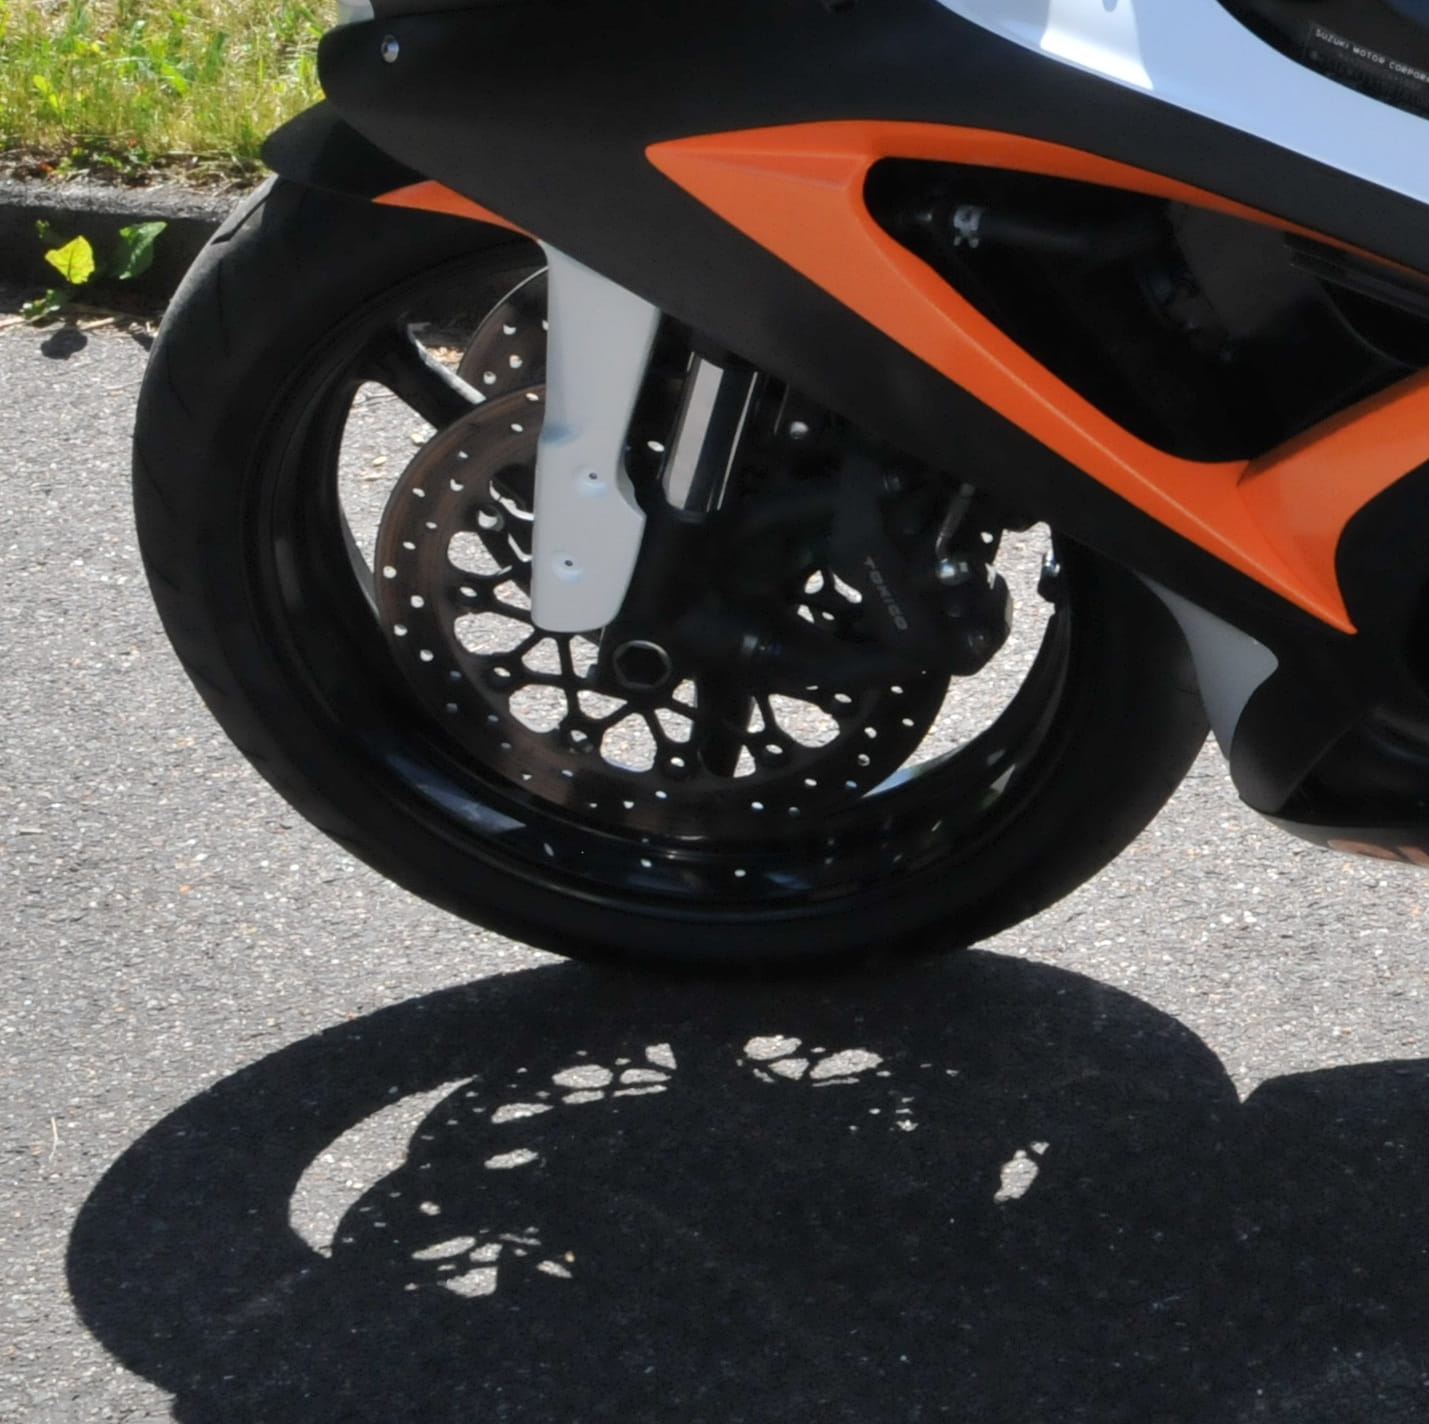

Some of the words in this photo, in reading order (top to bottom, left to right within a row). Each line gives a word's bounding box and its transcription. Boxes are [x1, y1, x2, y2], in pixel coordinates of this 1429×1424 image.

[1315, 28, 1349, 49] SUZUKI
[1353, 46, 1386, 65] MOTOR
[864, 556, 908, 630] TOKICO
